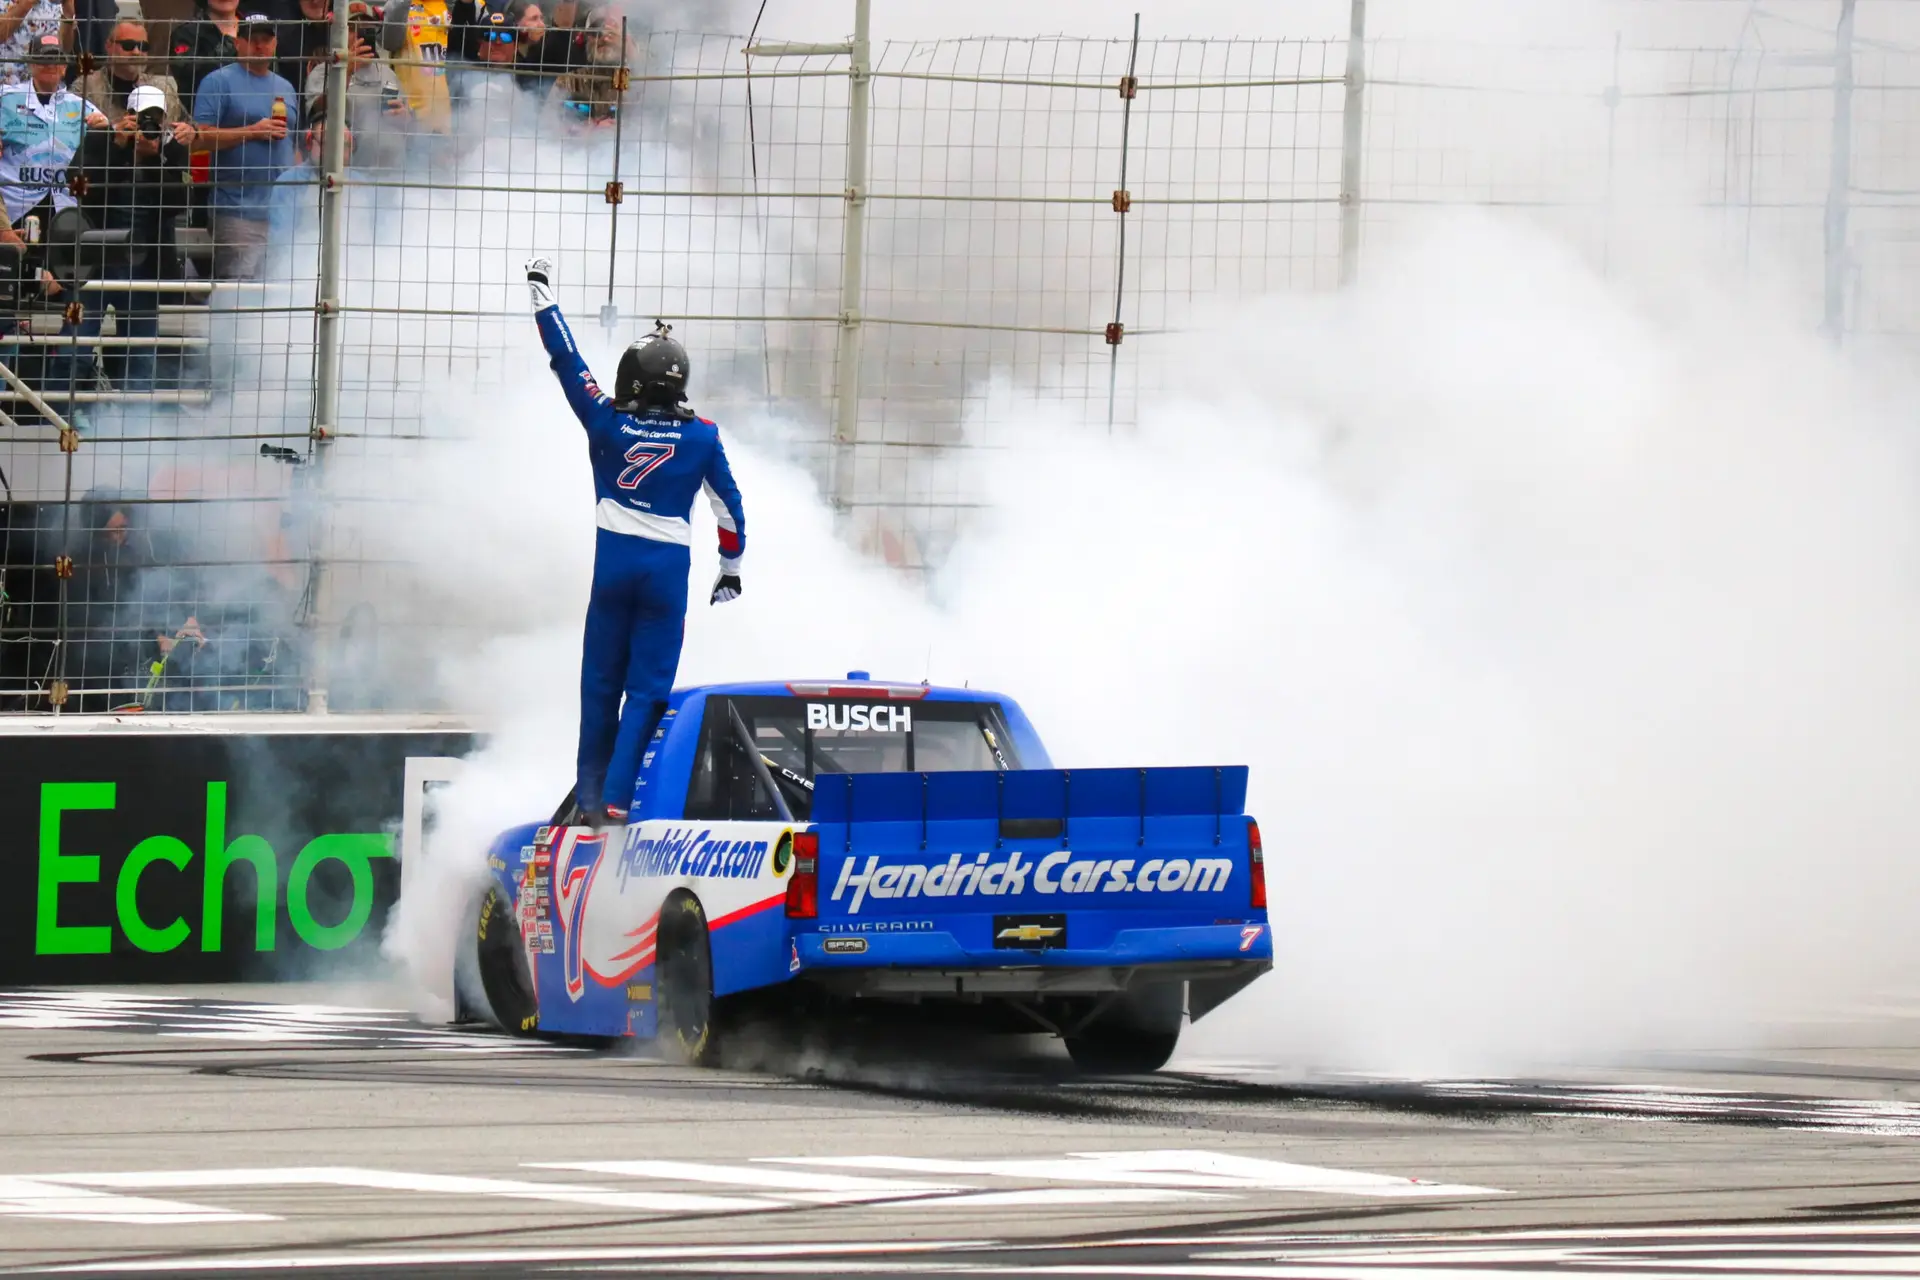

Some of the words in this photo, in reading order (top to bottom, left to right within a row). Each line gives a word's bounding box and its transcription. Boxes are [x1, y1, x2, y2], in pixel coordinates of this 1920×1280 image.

[617, 441, 676, 490] 7
[805, 702, 912, 734] BUSCH
[616, 827, 768, 895] HendrickCars.com
[829, 849, 1234, 915] HendrickCars.com
[478, 886, 496, 940] EAGLE
[561, 832, 609, 1005] 7
[818, 920, 934, 933] SILVERADO
[1239, 925, 1264, 952] 7
